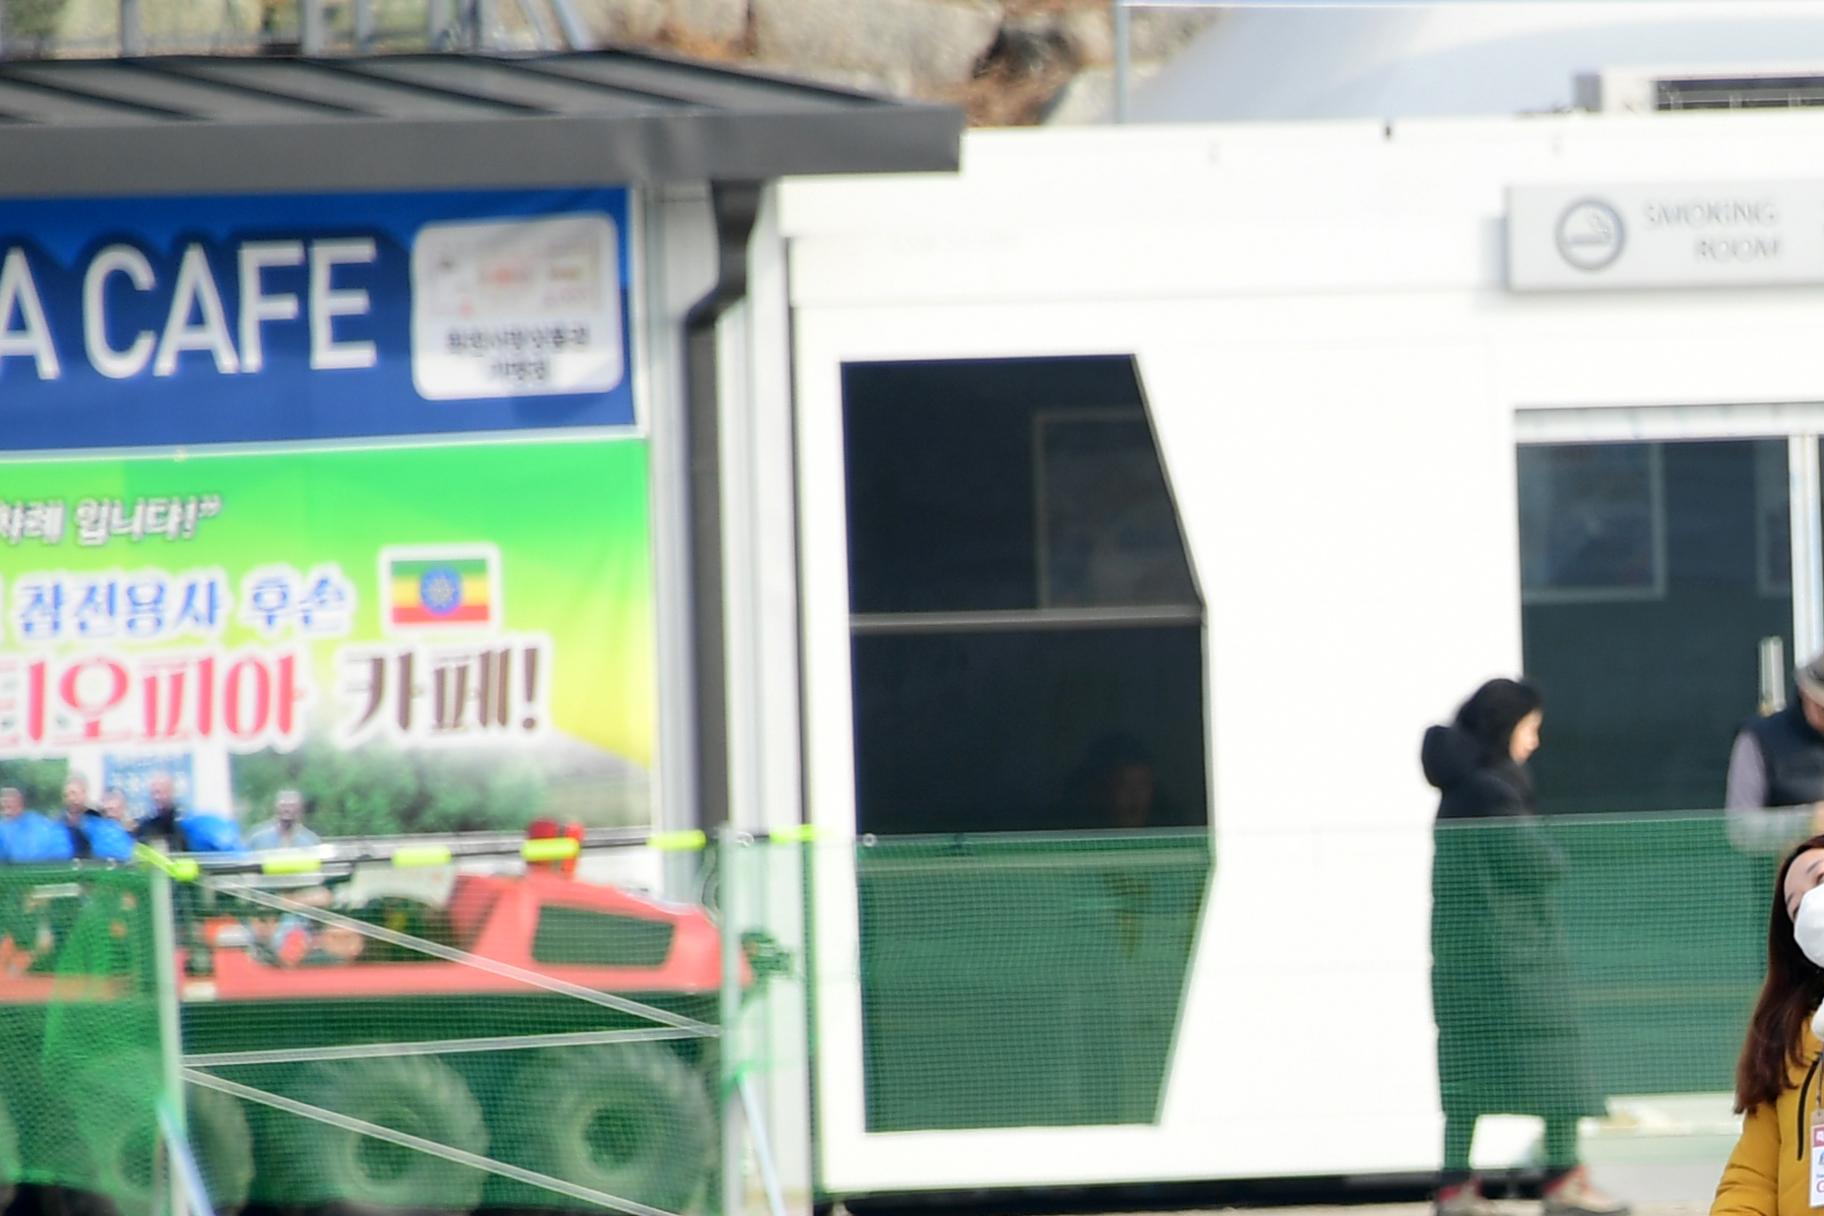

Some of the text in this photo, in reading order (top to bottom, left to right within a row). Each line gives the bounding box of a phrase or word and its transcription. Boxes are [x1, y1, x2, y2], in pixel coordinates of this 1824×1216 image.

[1644, 202, 1776, 229] SMOKING
[1697, 236, 1780, 263] ROOM
[83, 235, 378, 380] CAFE
[250, 575, 347, 632] 후손
[350, 644, 542, 736] 카페!
